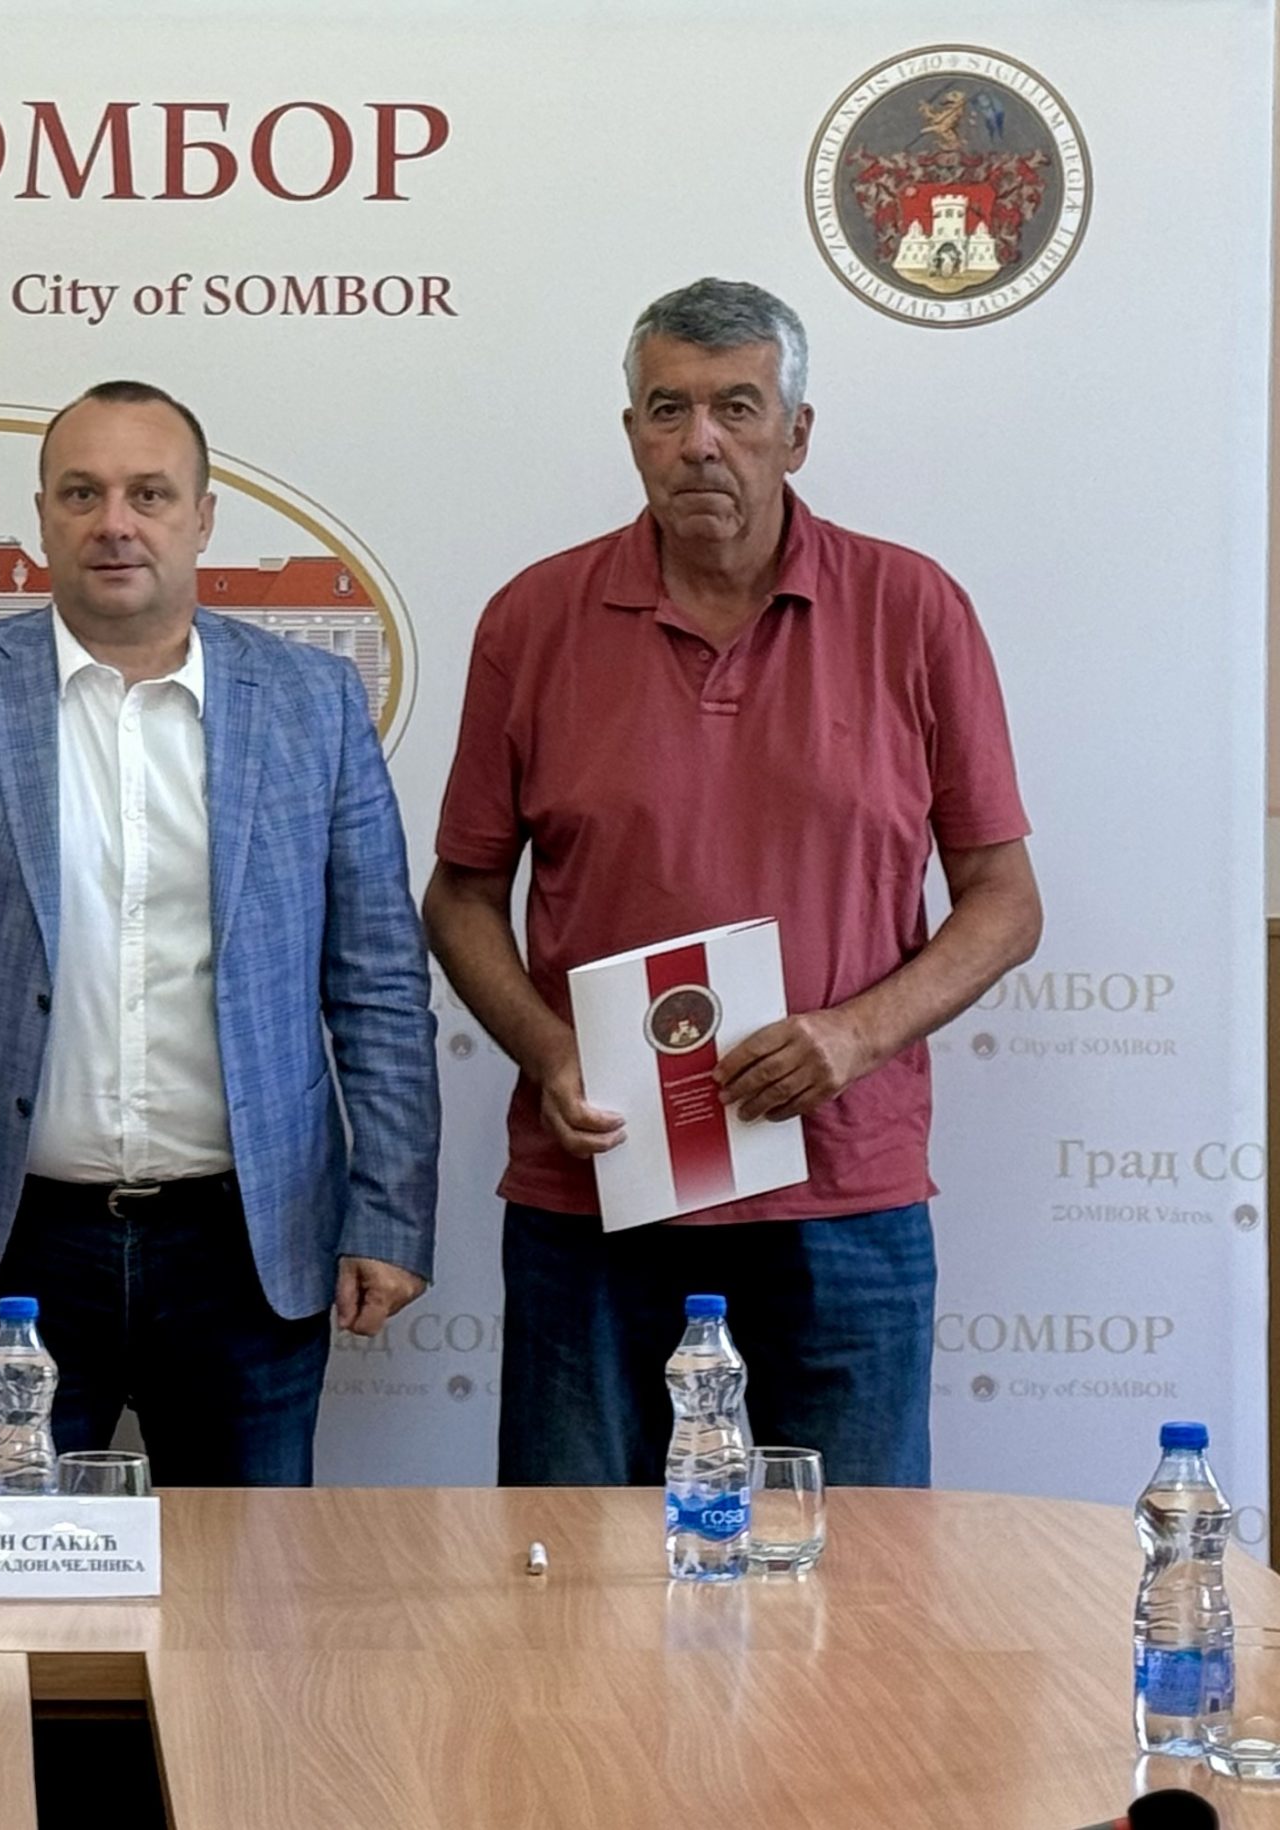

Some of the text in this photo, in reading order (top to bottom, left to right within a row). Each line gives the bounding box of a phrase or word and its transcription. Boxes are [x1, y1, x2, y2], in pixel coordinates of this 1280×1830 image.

[12, 273, 459, 324] City of SOMBOR
[1008, 1037, 1179, 1059] City of SOMBOR
[1055, 1139, 1180, 1188] Град
[1051, 1204, 1150, 1223] ZOMBOR
[1008, 1378, 1180, 1401] City of SOMBOR
[701, 1508, 746, 1525] rosa
[21, 1533, 118, 1551] СТАКИЋ
